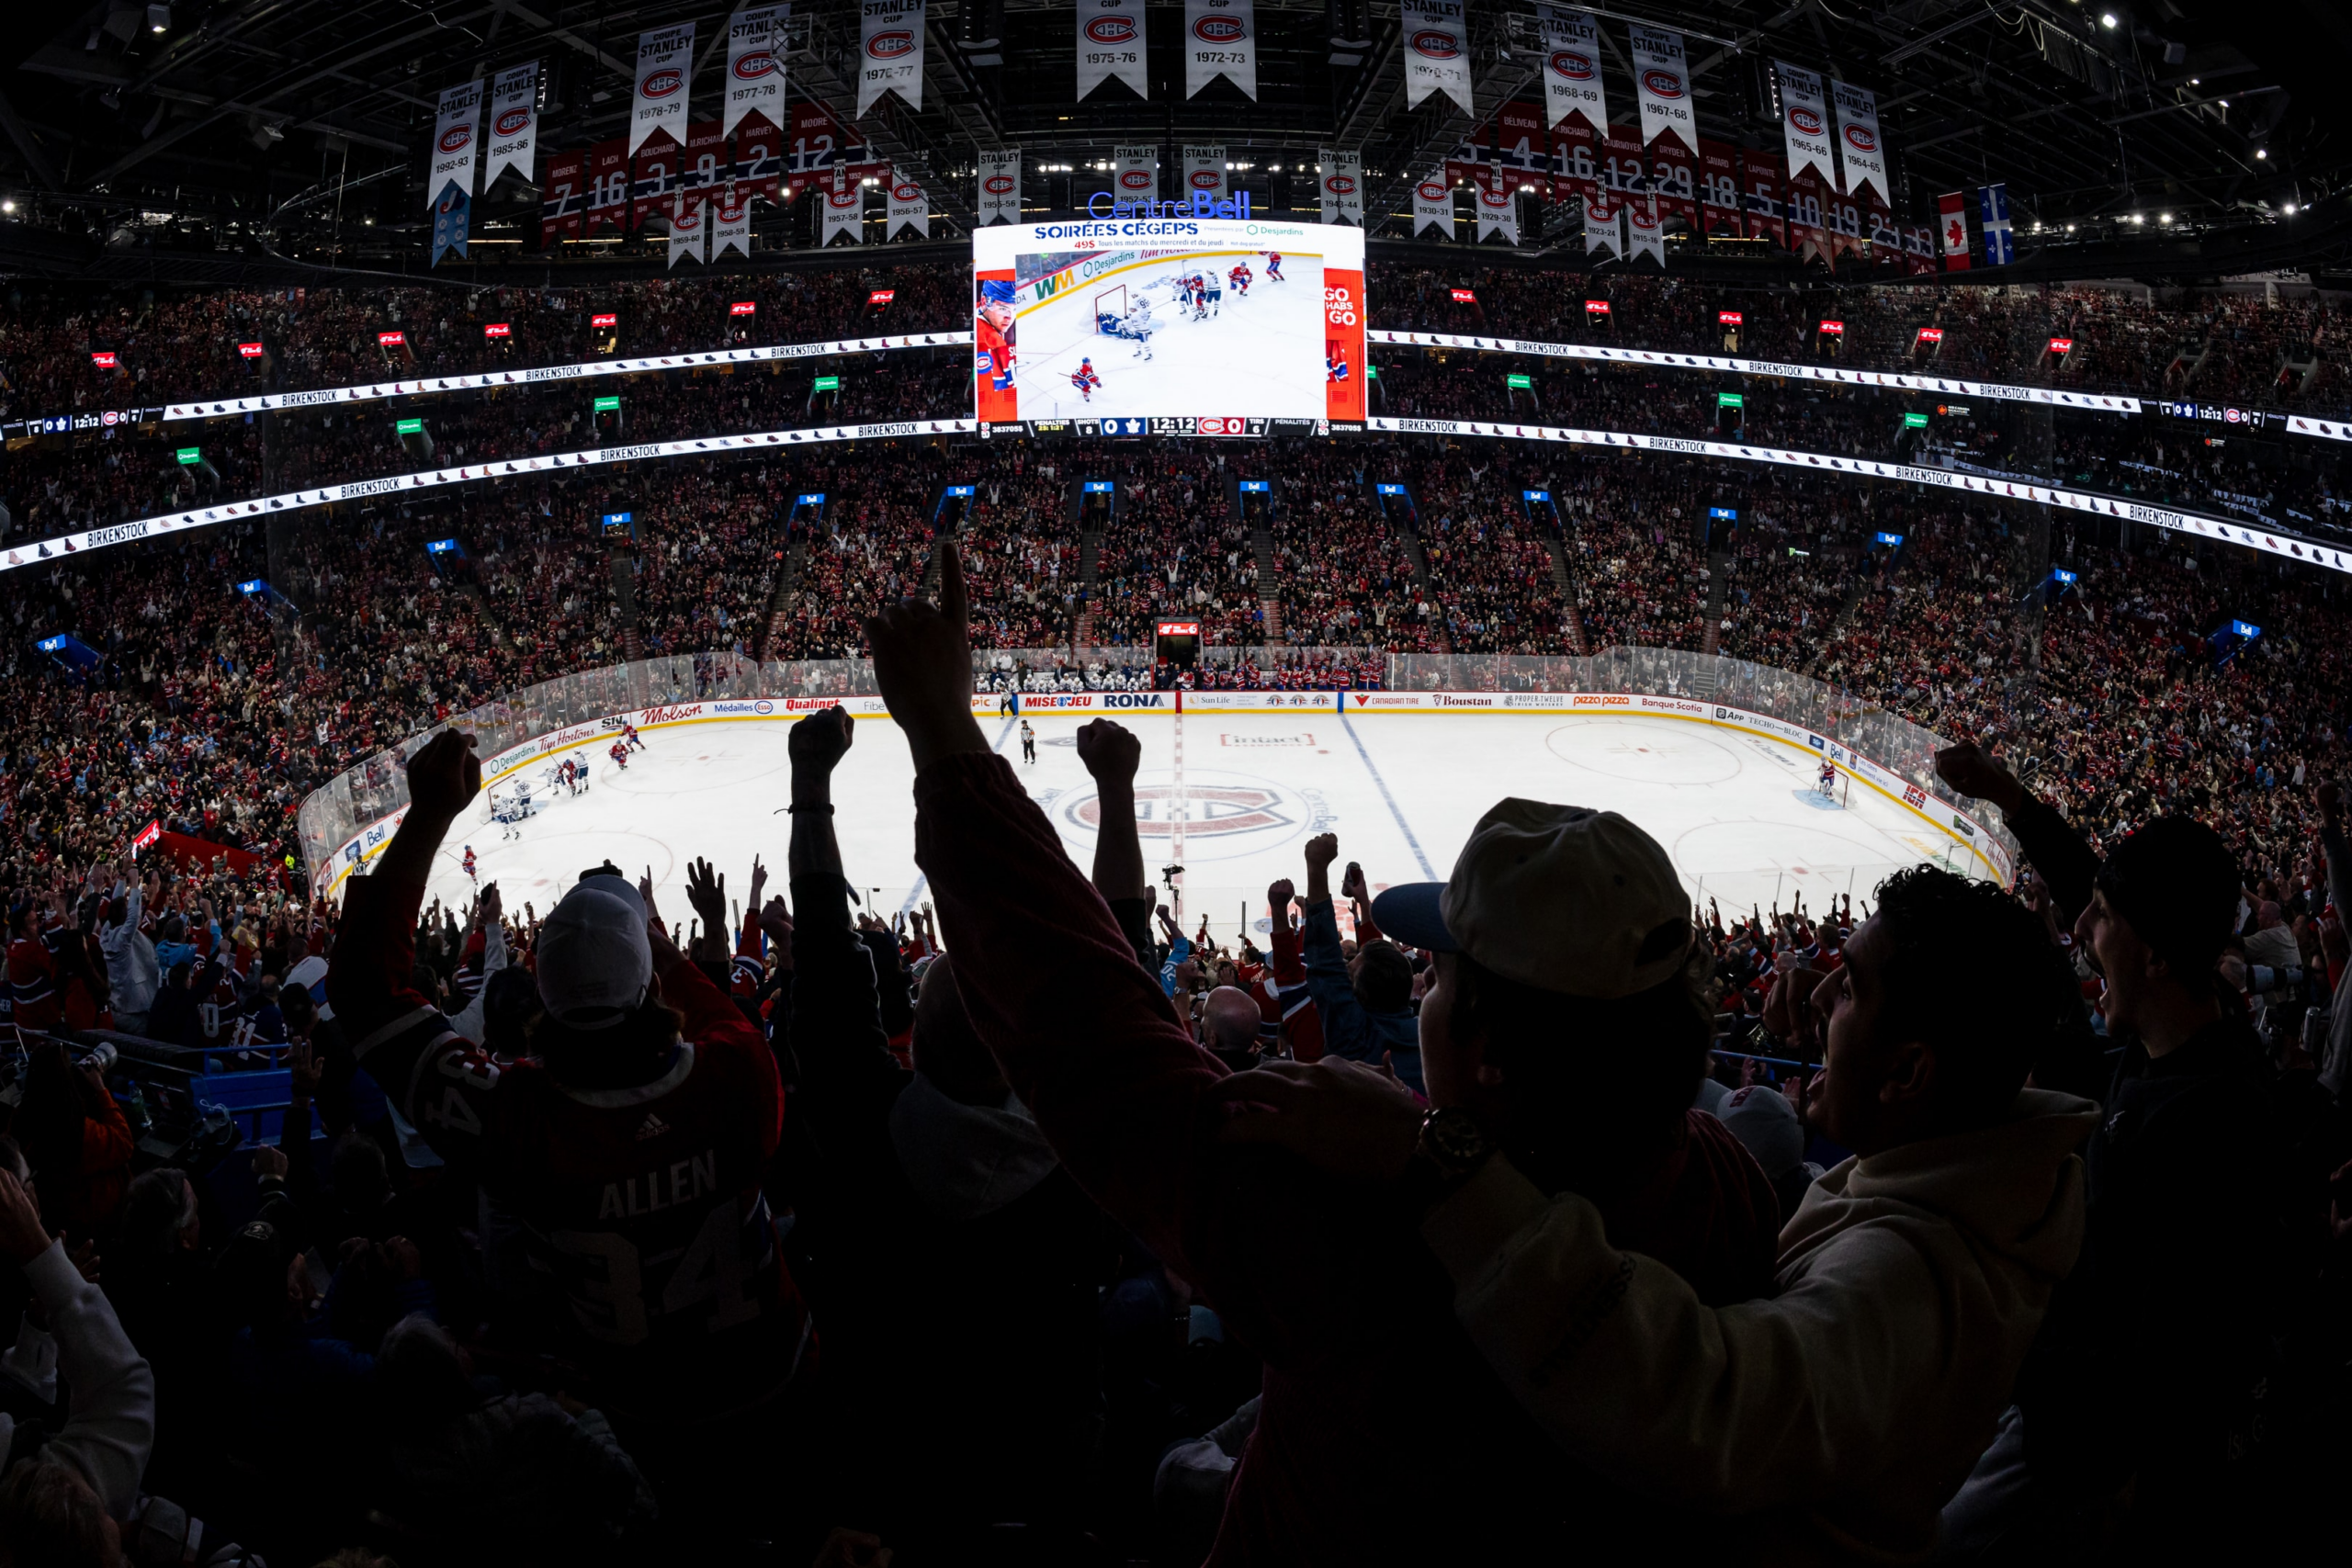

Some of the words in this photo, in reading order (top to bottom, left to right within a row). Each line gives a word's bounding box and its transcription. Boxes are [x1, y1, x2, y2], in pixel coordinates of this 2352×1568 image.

[864, 0, 922, 16] STANLEY
[1404, 0, 1461, 17] STANLEY
[883, 15, 902, 23] CUP
[1425, 15, 1443, 24] CUP
[639, 35, 692, 58] STANLEY
[1634, 38, 1682, 60] STANLEY
[656, 53, 673, 63] CUP
[1086, 52, 1136, 63] 1975-76
[1195, 51, 1245, 63] 1972-73
[1652, 54, 1668, 64] CUP
[495, 74, 537, 98] STANLEY
[731, 85, 776, 101] 1977-78
[1779, 74, 1821, 97] STANLEY
[1551, 85, 1597, 102] 1968-69
[439, 90, 481, 117] STANLEY
[1836, 93, 1874, 116] STANLEY
[639, 103, 681, 120] 1978-79
[1645, 103, 1688, 120] 1967-68
[801, 117, 828, 129] MOORE
[1504, 113, 1537, 130] BÉLIVEAU
[746, 125, 774, 138] HARVEY
[492, 139, 528, 157] 1985-86
[640, 142, 675, 158] BOUCHARD
[1602, 138, 1643, 153] COURNOYER
[1792, 138, 1826, 156] 1965-66
[602, 154, 619, 166] LACH
[792, 134, 833, 174] 12
[980, 152, 1020, 164] STANLEY
[1116, 149, 1156, 158] STANLEY
[1185, 149, 1225, 158] STANLEY
[1321, 153, 1359, 164] STANLEY
[1512, 136, 1534, 173] 4
[1556, 141, 1594, 181] 16
[435, 157, 469, 174] 1992-93
[748, 144, 768, 180] 2
[1848, 154, 1881, 174] 1964-65
[551, 164, 578, 178] MORENZ
[696, 152, 716, 189] 9
[1607, 156, 1645, 195] 12
[647, 162, 666, 197] 3
[1657, 162, 1693, 200] 29
[591, 170, 626, 210] 16
[1705, 172, 1737, 210] 18
[555, 182, 572, 219] 7
[1756, 182, 1774, 218] 5
[828, 213, 858, 223] 1957-58
[892, 207, 922, 216] 1956-57
[1419, 206, 1449, 216] 1930-31
[1482, 213, 1511, 222] 1929-30
[1792, 191, 1821, 231] 10
[1832, 201, 1860, 239] 19
[717, 228, 745, 238] 1958-59
[1035, 220, 1118, 240] SOIRÉES
[1122, 219, 1198, 236] CÉGEPS
[1261, 226, 1303, 236] Desjardins
[1589, 227, 1615, 237] 1923-24
[673, 234, 699, 245] 1959-60
[1074, 240, 1095, 249] 49$
[1208, 239, 1224, 247] jeudi
[1633, 233, 1658, 243] 1915-16
[1094, 251, 1136, 271] Desjardins
[1325, 288, 1349, 301] GO
[1326, 301, 1353, 310] HABS
[1329, 311, 1356, 326] GO
[772, 343, 826, 357] BIRKENSTOCK
[1515, 341, 1569, 355] BIRKENSTOCK
[526, 365, 582, 381] BIRKENSTOCK
[1748, 360, 1803, 377] BIRKENSTOCK
[282, 389, 338, 407] BIRKENSTOCK
[1979, 384, 2030, 400] BIRKENSTOCK
[2175, 404, 2182, 414] 0
[2199, 409, 2222, 421] 12:12
[74, 417, 99, 429] 12:12
[119, 412, 127, 422] 0
[1154, 418, 1195, 430] 12:12
[2241, 412, 2248, 422] 0
[46, 420, 53, 431] 0
[858, 422, 918, 437] BIRKENSTOCK
[1085, 426, 1092, 434] 8
[1104, 419, 1118, 434] 0
[1227, 419, 1241, 434] 0
[1252, 426, 1260, 434] 6
[1398, 419, 1459, 434] BIRKENSTOCK
[1649, 436, 1707, 454] BIRKENSTOCK
[600, 444, 661, 462] BIRKENSTOCK
[1895, 466, 1953, 487] BIRKENSTOCK
[341, 477, 401, 498] BIRKENSTOCK
[611, 514, 623, 523] Bell
[2129, 504, 2185, 531] BIRKENSTOCK
[87, 520, 149, 547] BIRKENSTOCK
[435, 541, 446, 550] Bell
[2061, 571, 2071, 581] Bell
[243, 582, 254, 592] Bell
[2241, 624, 2252, 636] Bell
[44, 639, 57, 649] Bell
[714, 702, 753, 714] Médailles
[757, 704, 771, 712] Esso
[786, 698, 842, 712] Qualinet
[1104, 694, 1164, 707] RONA
[1443, 695, 1492, 706] Boustan
[1574, 696, 1600, 706] pizza
[1602, 696, 1629, 706] pizza
[1642, 698, 1674, 710] Banque
[1677, 701, 1702, 713] Scotia
[640, 705, 702, 725] Molson
[538, 732, 557, 751] Tim
[558, 727, 594, 746] Hortons
[1234, 735, 1302, 744] intact
[499, 744, 537, 770] Desjardins
[1830, 743, 1843, 761] Bell
[367, 825, 386, 847] Bell
[598, 1147, 717, 1221] ALLEN
[548, 1195, 763, 1348] 34
